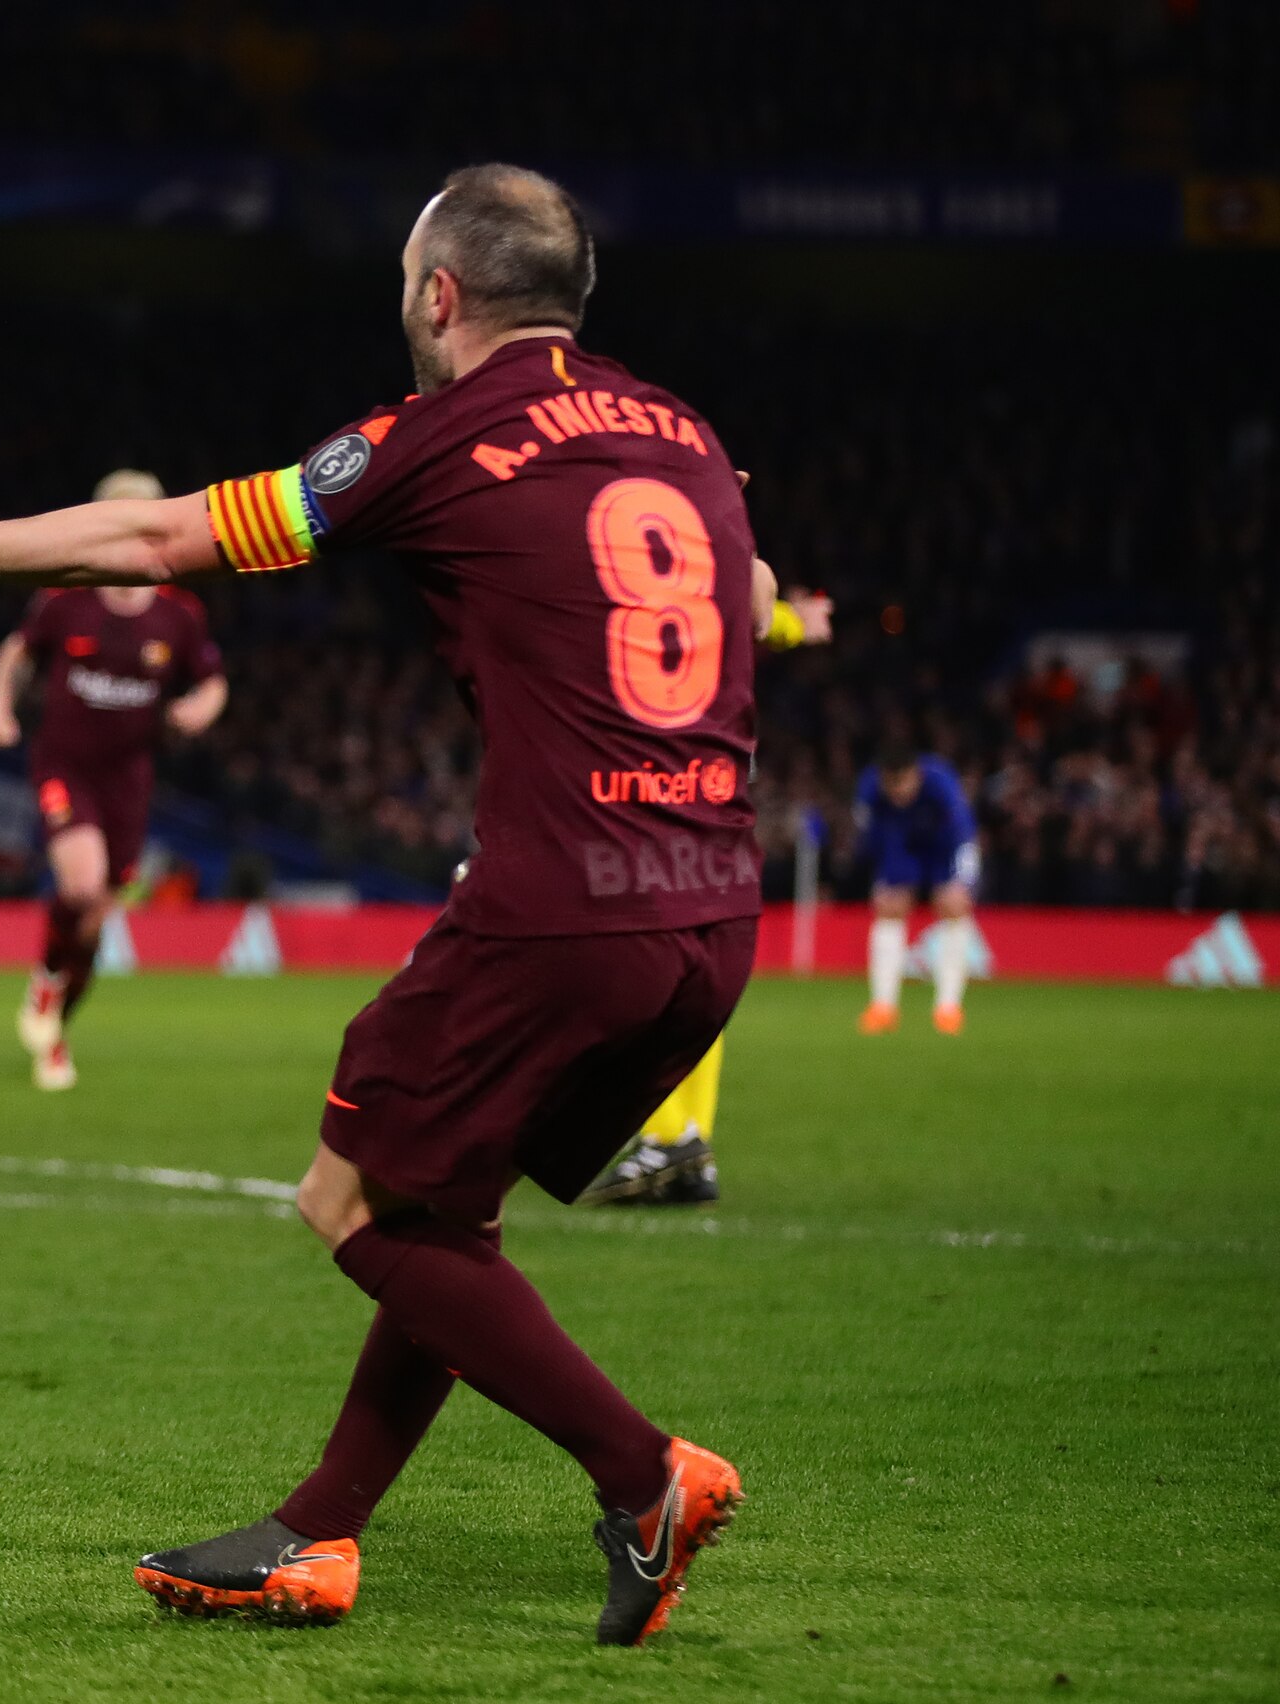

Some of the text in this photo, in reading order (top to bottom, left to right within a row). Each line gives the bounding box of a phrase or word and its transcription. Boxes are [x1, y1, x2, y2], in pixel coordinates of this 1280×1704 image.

[471, 390, 708, 481] A. INIESTA
[586, 477, 724, 729] 8
[590, 759, 702, 804] unicef
[584, 835, 759, 897] BARÇA
